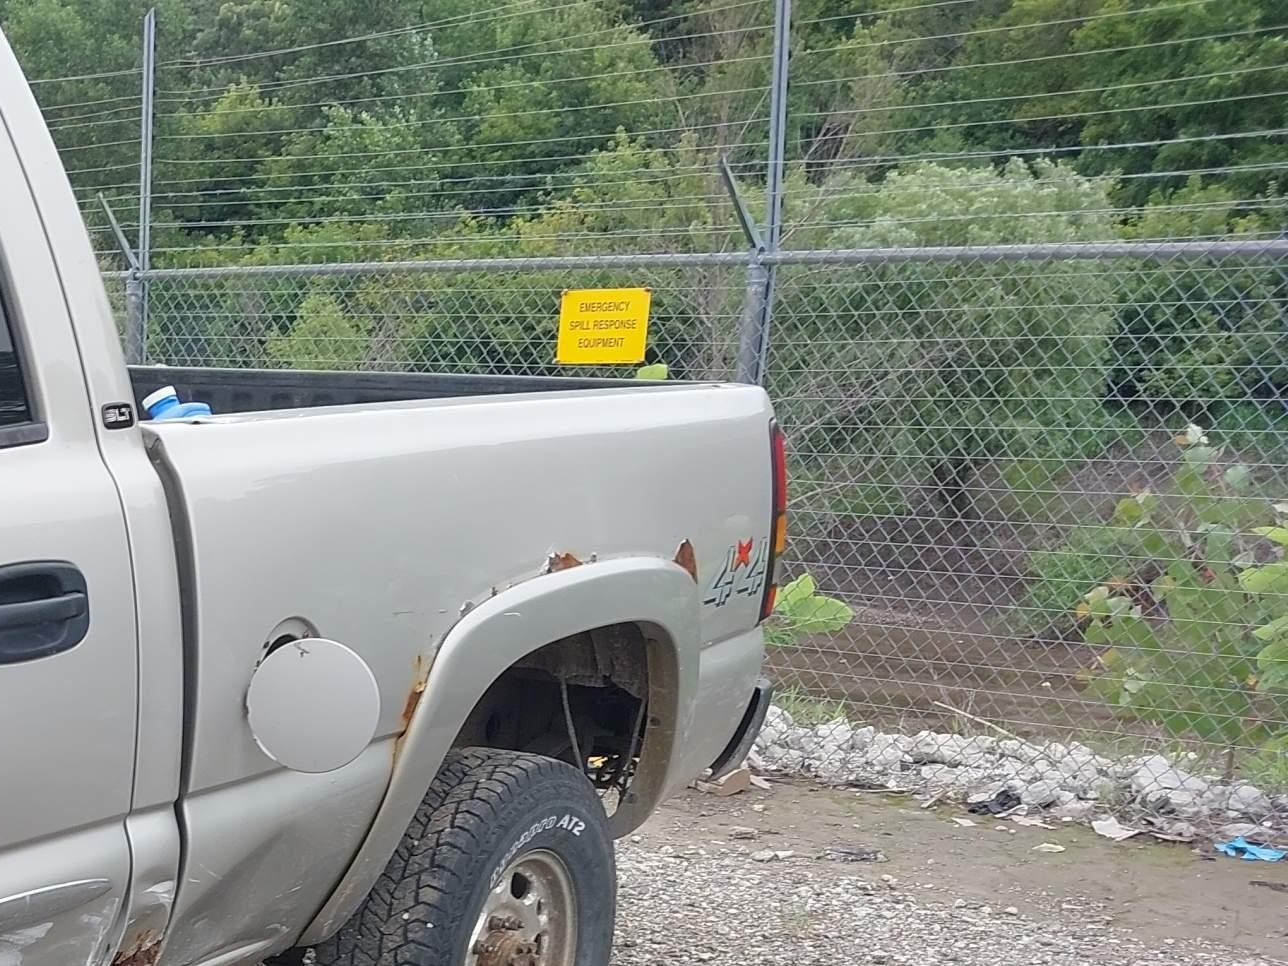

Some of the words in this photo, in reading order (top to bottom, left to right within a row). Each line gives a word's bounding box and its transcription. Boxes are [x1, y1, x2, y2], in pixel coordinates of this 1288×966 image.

[579, 301, 629, 312] EMERGENCY
[569, 320, 591, 330] SPILL
[593, 319, 636, 330] RESPONSE
[578, 338, 624, 348] EQUIPMENT
[104, 408, 130, 423] SLT
[556, 814, 586, 837] AT2
